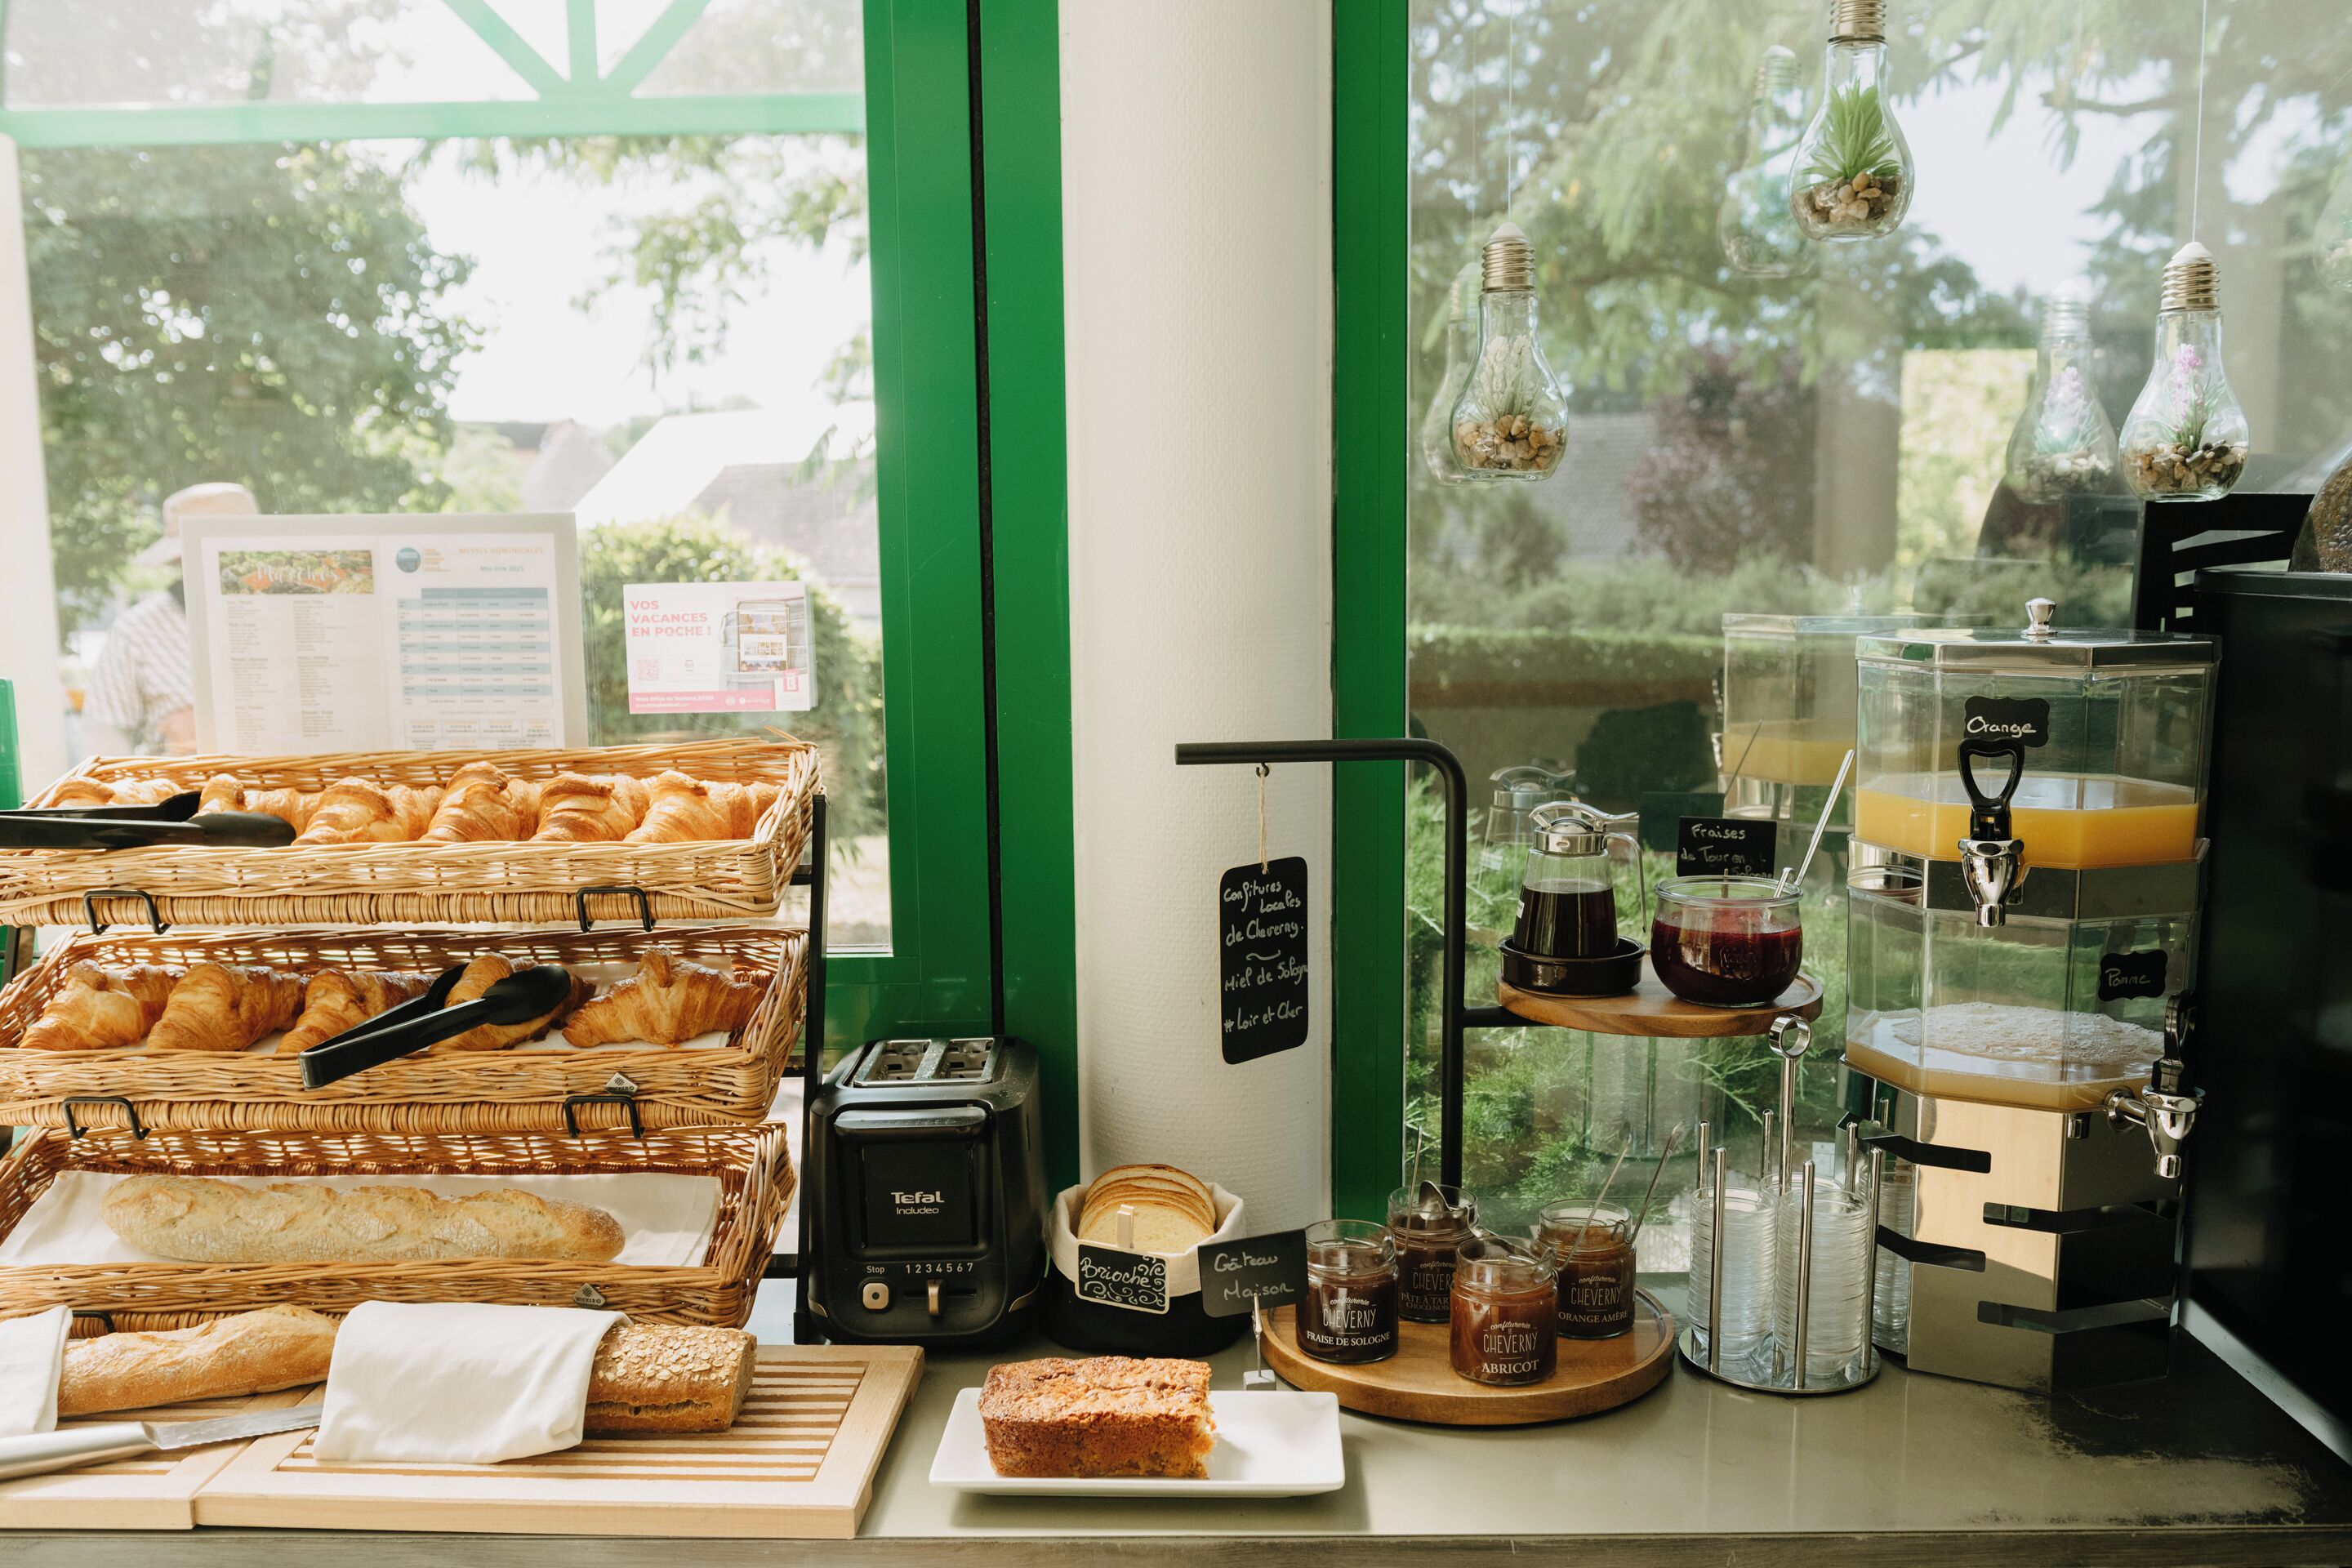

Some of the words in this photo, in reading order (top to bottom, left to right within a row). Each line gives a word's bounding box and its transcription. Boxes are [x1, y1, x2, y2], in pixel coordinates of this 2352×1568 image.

[630, 600, 659, 610] VOS
[631, 612, 708, 623] VACANCES
[632, 626, 650, 636] EN
[654, 626, 703, 636] POCHE
[1967, 715, 2037, 738] Orange
[1690, 823, 1746, 840] Fraises
[1681, 847, 1696, 861] de
[1223, 880, 1282, 912] Confitures
[1259, 889, 1302, 914] Locales
[1226, 924, 1245, 947] de
[1225, 967, 1252, 991] Miel
[1257, 967, 1273, 986] de
[2105, 968, 2151, 987] Pomme
[1263, 1006, 1276, 1025] et
[1276, 1000, 1303, 1021] Cher
[890, 1191, 945, 1205] Tefal
[896, 1206, 939, 1214] Includeo
[866, 1265, 885, 1275] Stop
[1080, 1256, 1152, 1289] Brioche
[1413, 1272, 1451, 1291] CHEVER
[1578, 1275, 1616, 1285] confiturerie
[1223, 1279, 1294, 1301] Maison
[1570, 1285, 1622, 1306] CHEVERNY
[1330, 1297, 1370, 1306] confiturerie
[1323, 1307, 1377, 1329] CHEVERNY
[1558, 1312, 1600, 1323] ORANGE
[1601, 1309, 1628, 1323] AMÈRE
[1490, 1321, 1531, 1331] confiturerie
[1307, 1330, 1334, 1345] FRAISE
[1335, 1337, 1350, 1347] DE
[1350, 1331, 1391, 1347] SOLOGNE
[1483, 1331, 1538, 1354] CHEVERNY
[1481, 1359, 1539, 1374] ABRICOT
